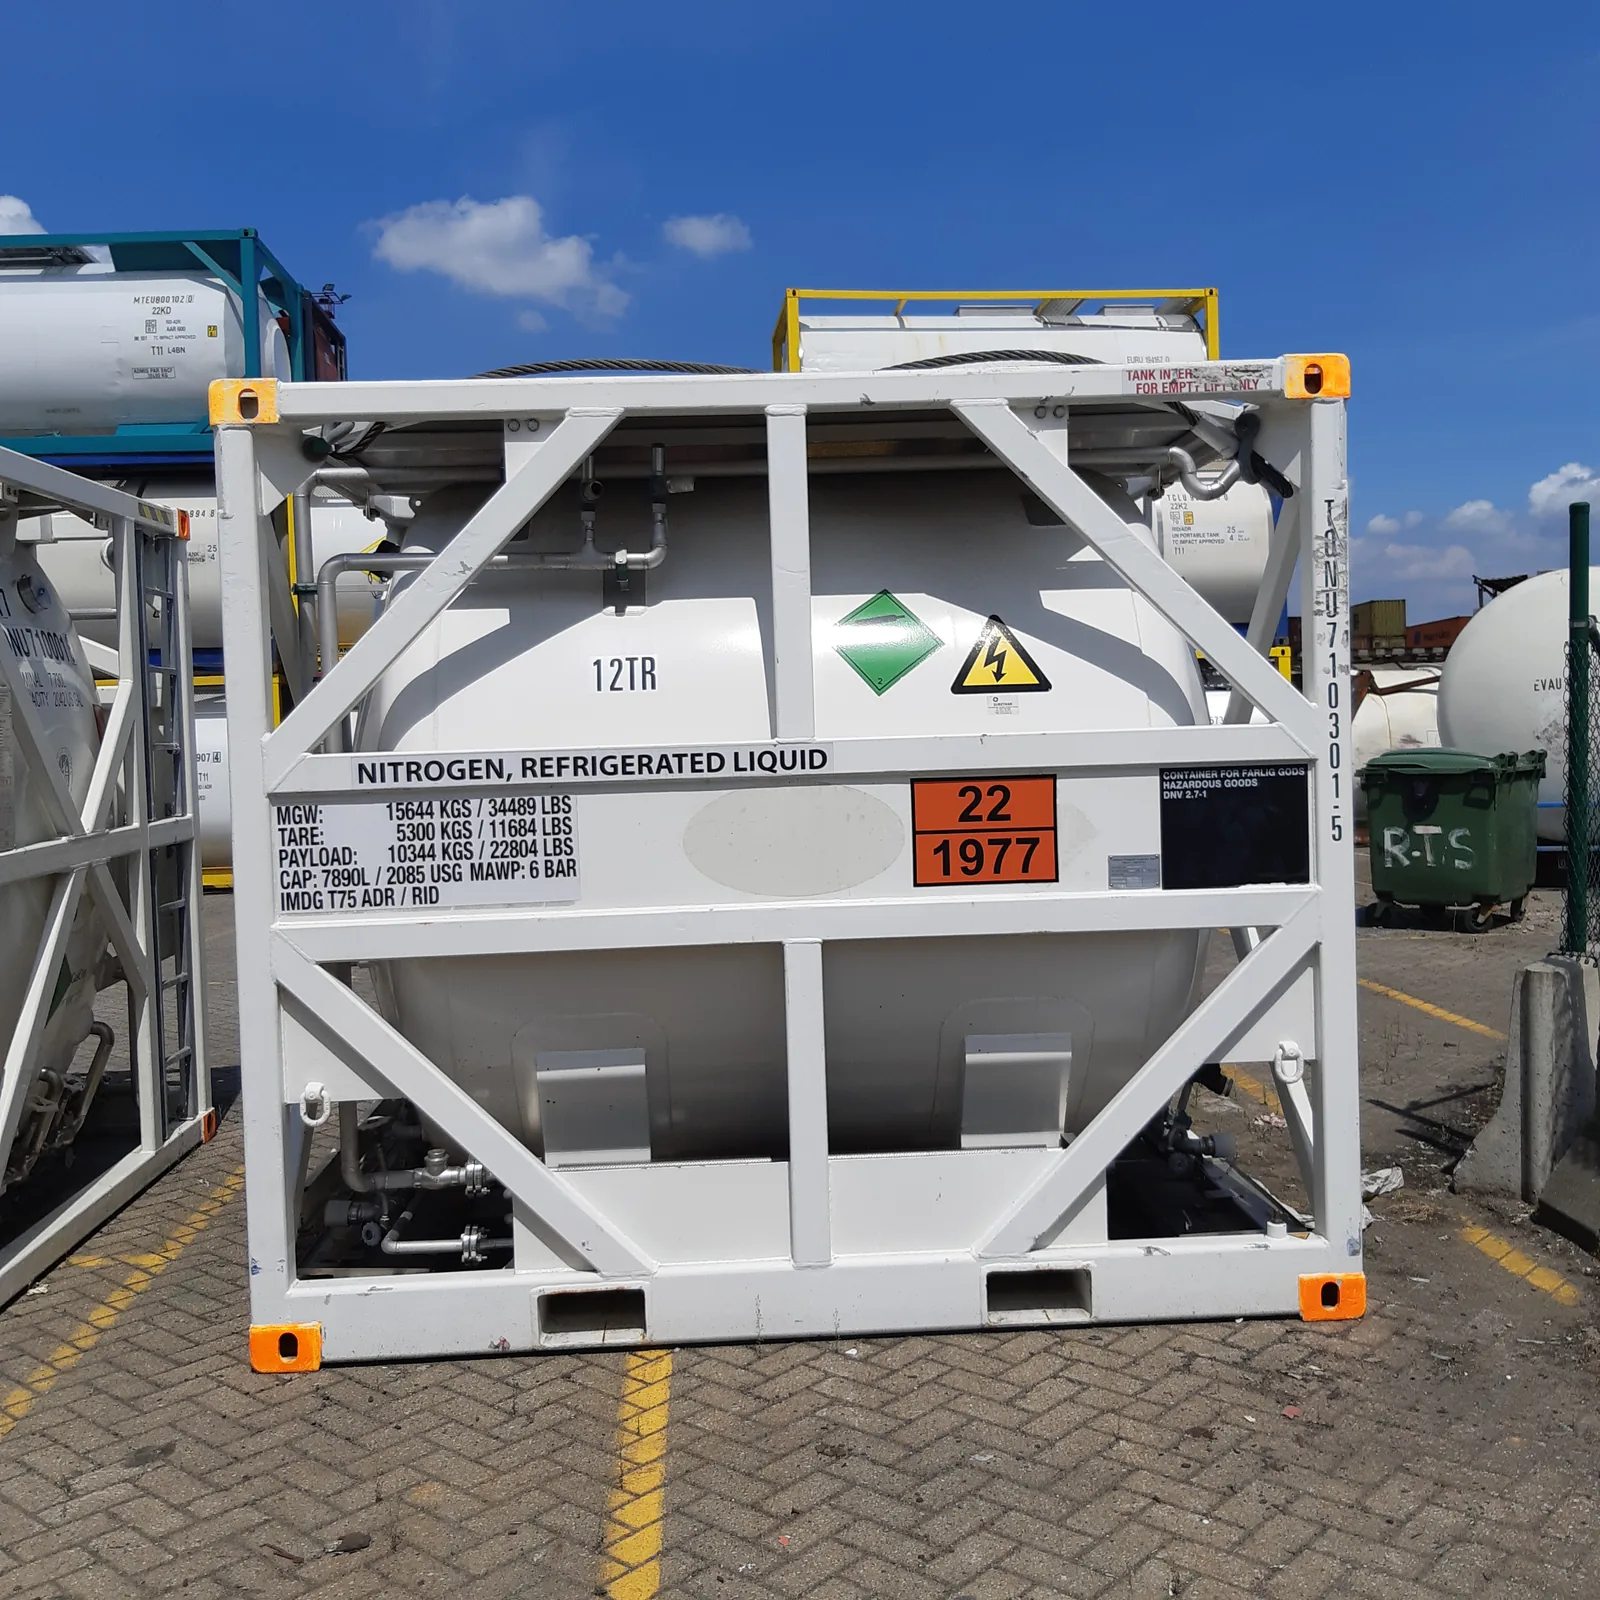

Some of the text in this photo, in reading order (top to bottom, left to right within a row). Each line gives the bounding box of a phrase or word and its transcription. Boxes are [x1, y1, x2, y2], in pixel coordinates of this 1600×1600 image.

[152, 306, 172, 315] 22KD
[151, 346, 163, 355] T11
[1126, 369, 1156, 381] TANK
[1136, 382, 1158, 394] FOR
[592, 657, 657, 692] 12TR
[877, 677, 884, 685] 2
[1534, 678, 1562, 691] EVAU
[358, 748, 828, 784] NITROGEN, REFRIGERATED LIQUID
[198, 772, 209, 782] T11
[1163, 767, 1305, 780] CONTAINER FOR FARLIG GODS
[1163, 778, 1258, 790] HAZARDOUS GOODS
[1163, 790, 1207, 799] DNV 2.7-1
[957, 784, 1011, 823] 22
[277, 795, 572, 826] MGW: 15644 KGS / 34489 LBS
[278, 816, 573, 847] TARE: 5300 KGS / 11684 LBS
[279, 837, 574, 868] PAYLOAD: 10344 KGS / 22804 LBS
[933, 837, 1040, 876] 1977
[280, 858, 578, 889] CAP: 7890L / 2085 USG MAWP: 6 BAR
[280, 885, 440, 911] IMDG T75 ADR / RID
